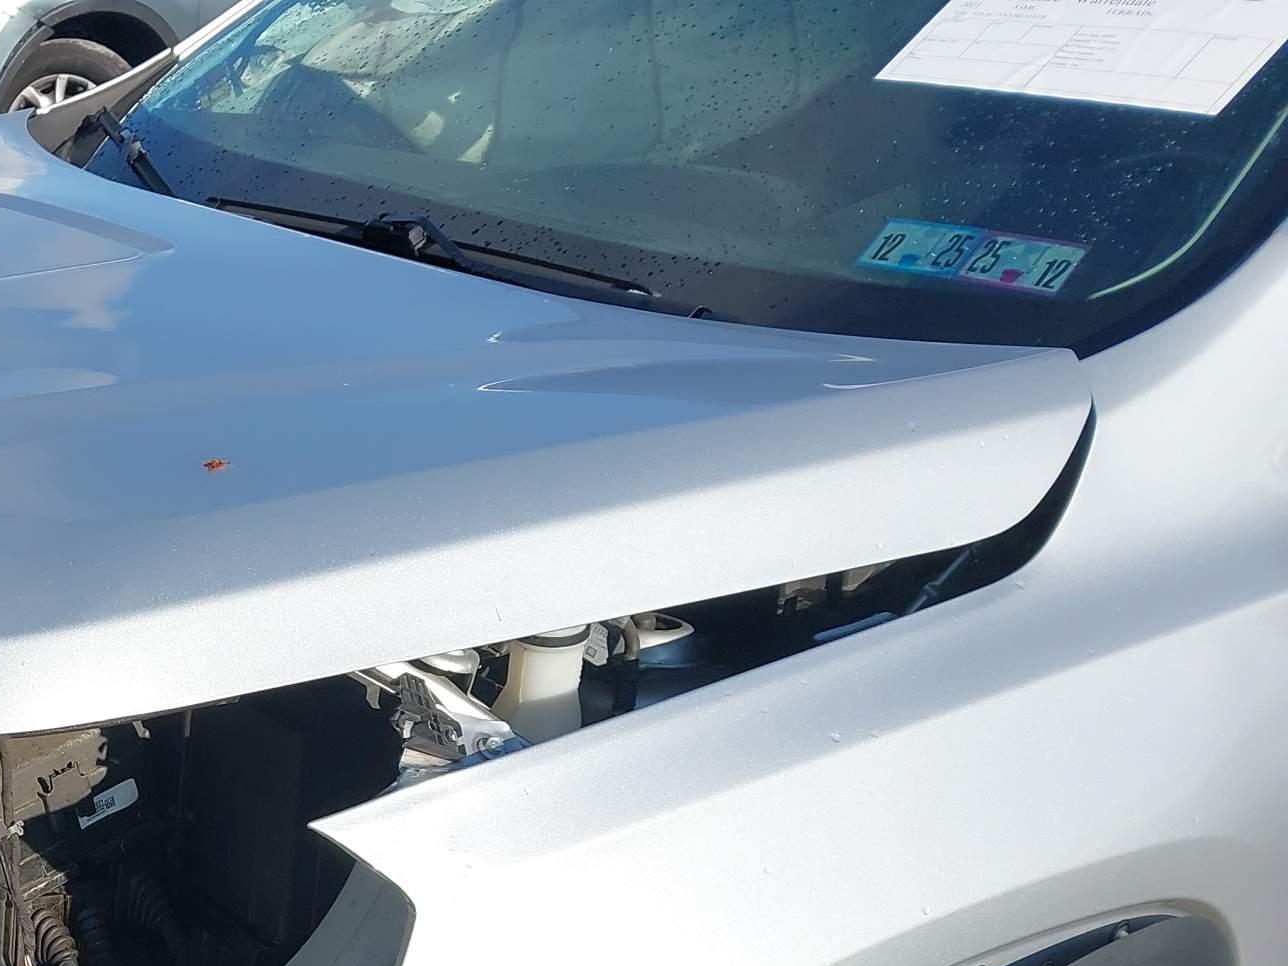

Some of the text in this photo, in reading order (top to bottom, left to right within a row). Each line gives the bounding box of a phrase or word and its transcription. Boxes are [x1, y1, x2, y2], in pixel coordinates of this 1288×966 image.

[872, 233, 976, 268] 12 25
[967, 240, 1072, 289] 25 12
